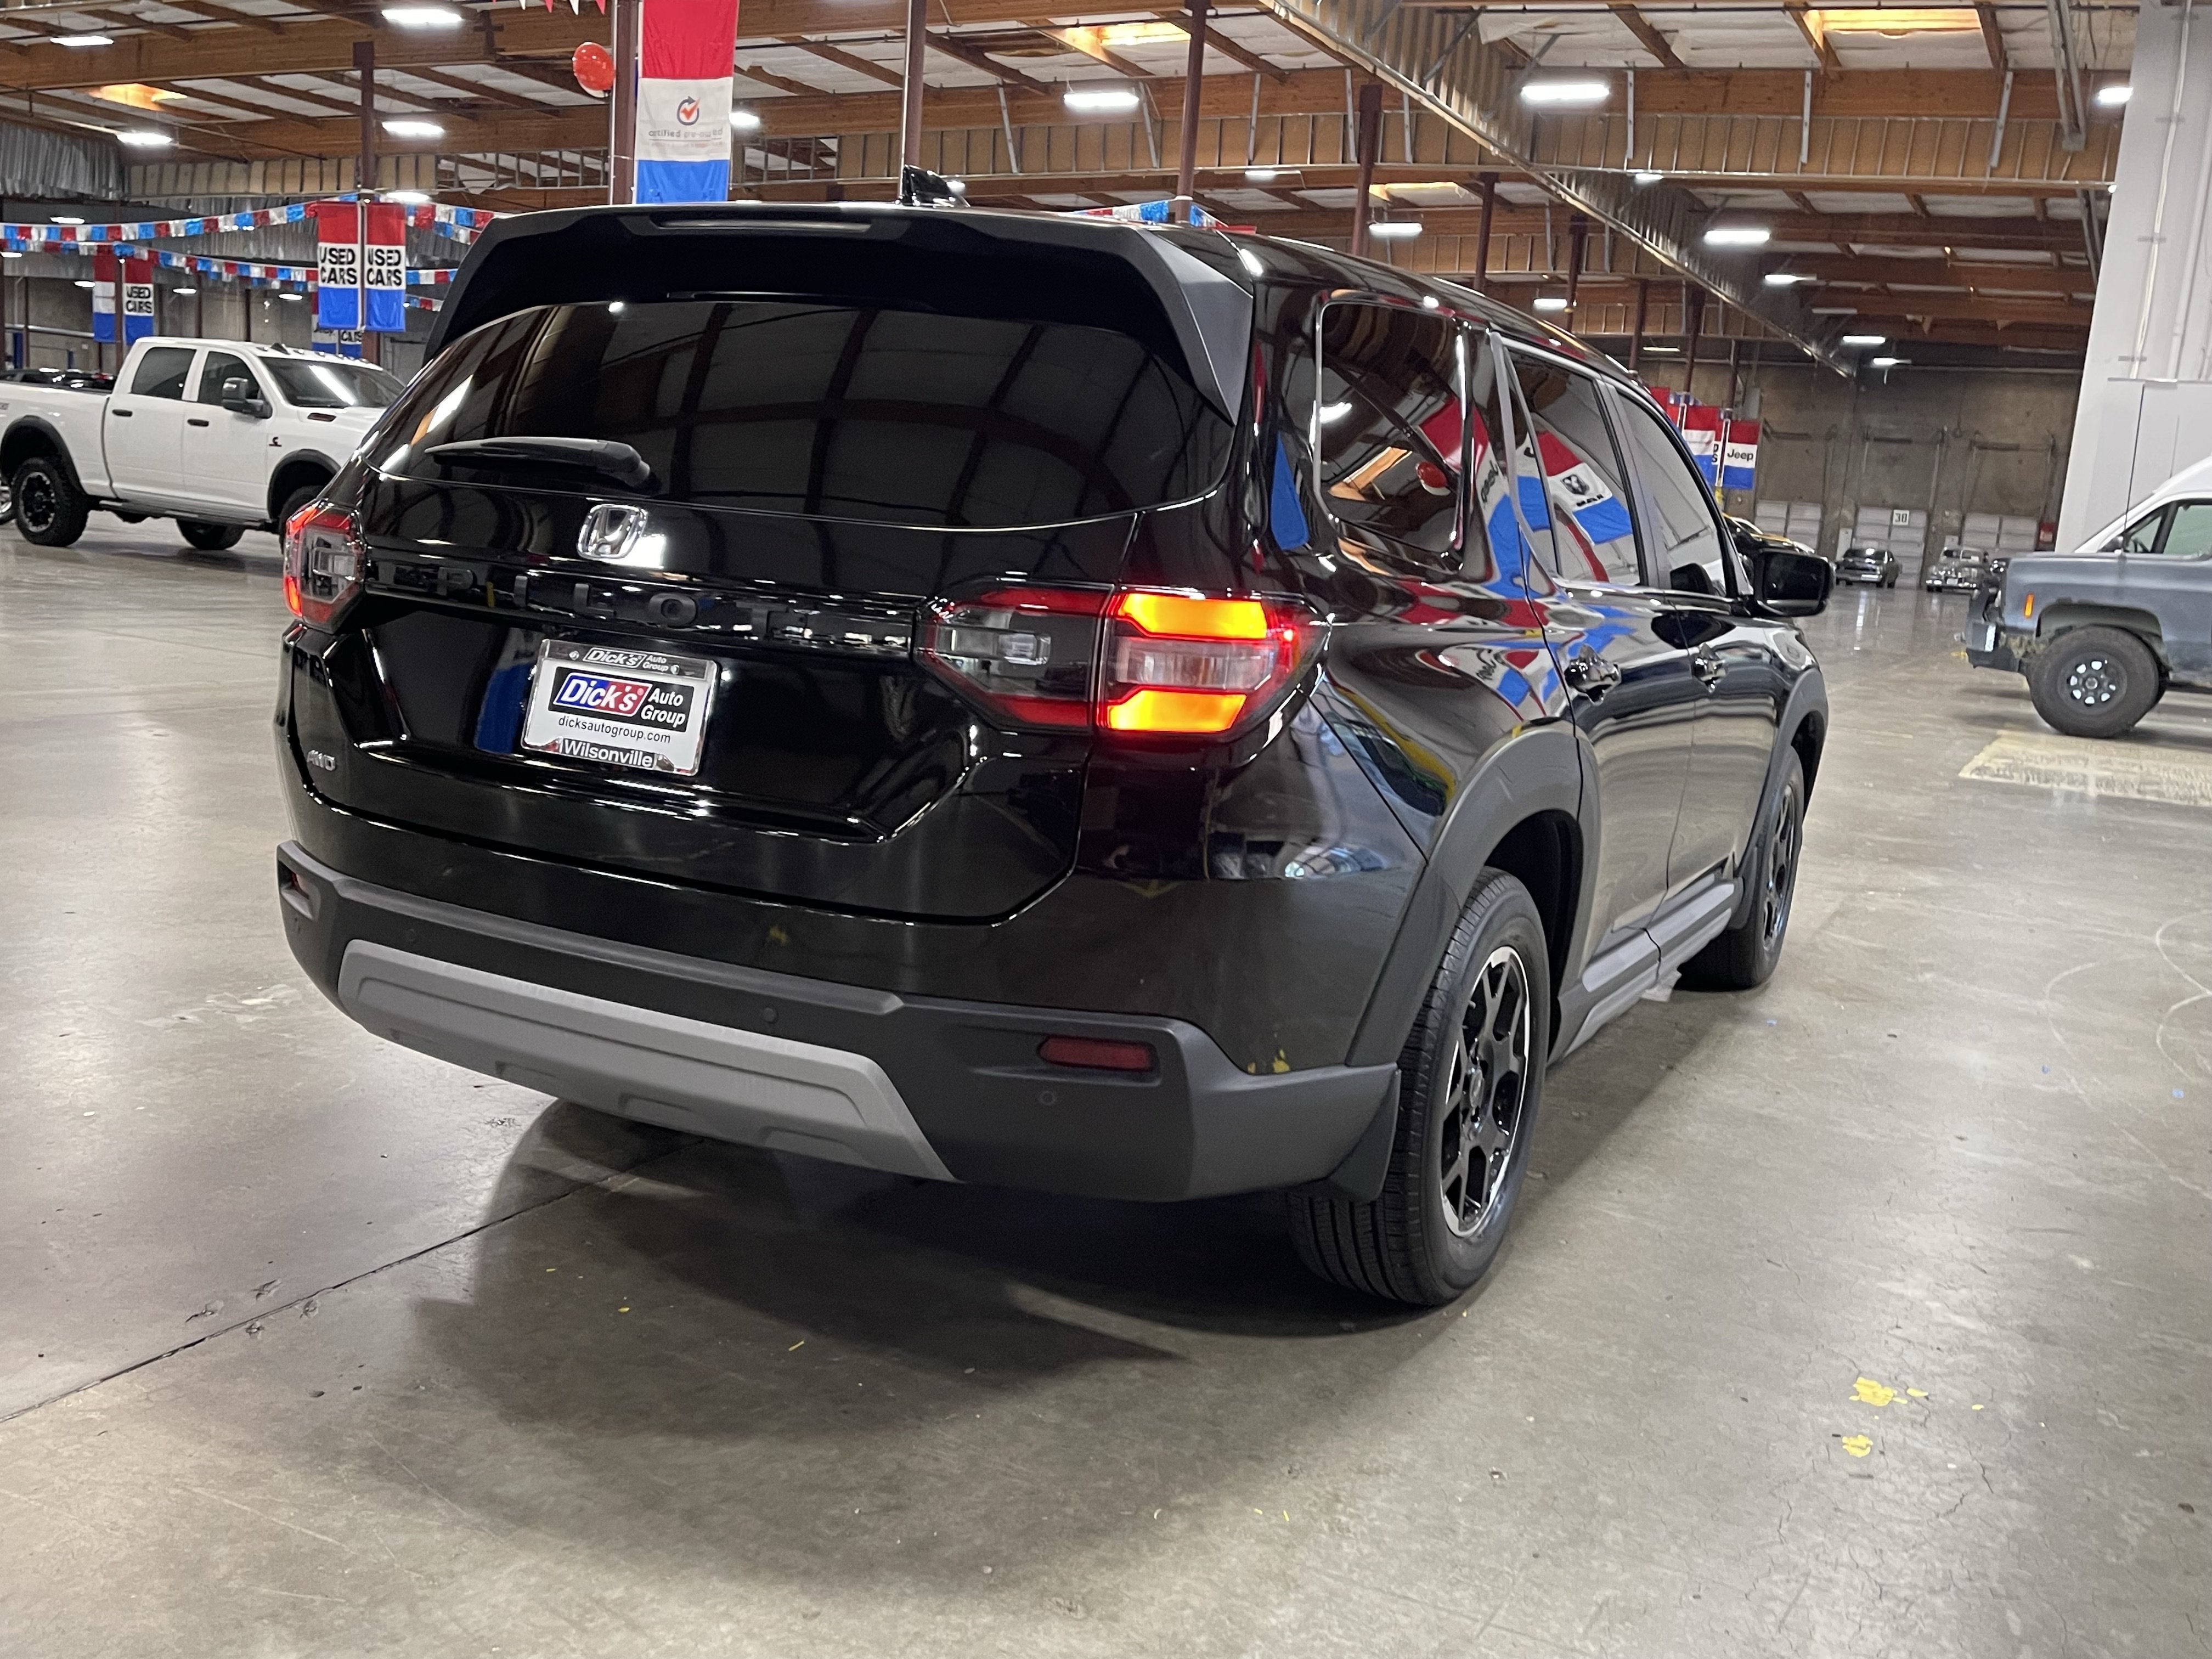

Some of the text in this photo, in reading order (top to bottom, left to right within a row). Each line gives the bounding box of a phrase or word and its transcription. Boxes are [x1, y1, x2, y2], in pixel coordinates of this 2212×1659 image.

[319, 246, 356, 265] USED
[368, 247, 401, 266] USED
[320, 266, 357, 285] CARS
[366, 267, 402, 286] CARS
[1727, 448, 1754, 461] Jeep
[588, 650, 667, 666] Dick's Auto
[642, 662, 669, 672] Group
[560, 679, 684, 712] Dick's Auto
[641, 704, 686, 729] Group
[558, 715, 671, 743] dicksautogroup.com
[564, 738, 653, 768] Wilsonville
